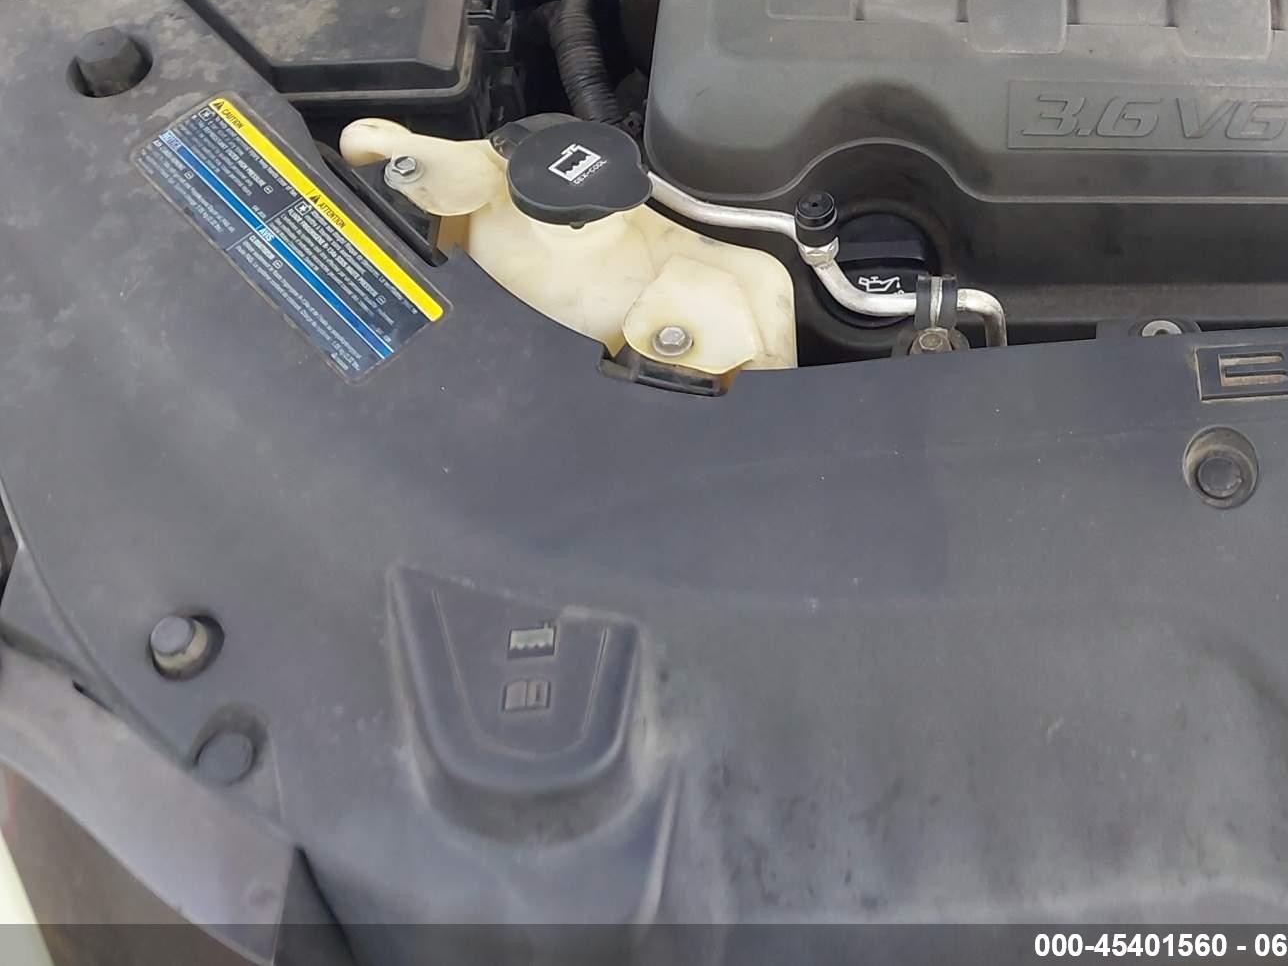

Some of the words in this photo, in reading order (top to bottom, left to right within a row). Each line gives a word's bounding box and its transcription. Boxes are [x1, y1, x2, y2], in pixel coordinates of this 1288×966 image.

[219, 107, 245, 130] CAUTION
[1020, 94, 1163, 138] 3.6
[315, 200, 348, 229] ATTENTION
[257, 226, 275, 242] AVIS
